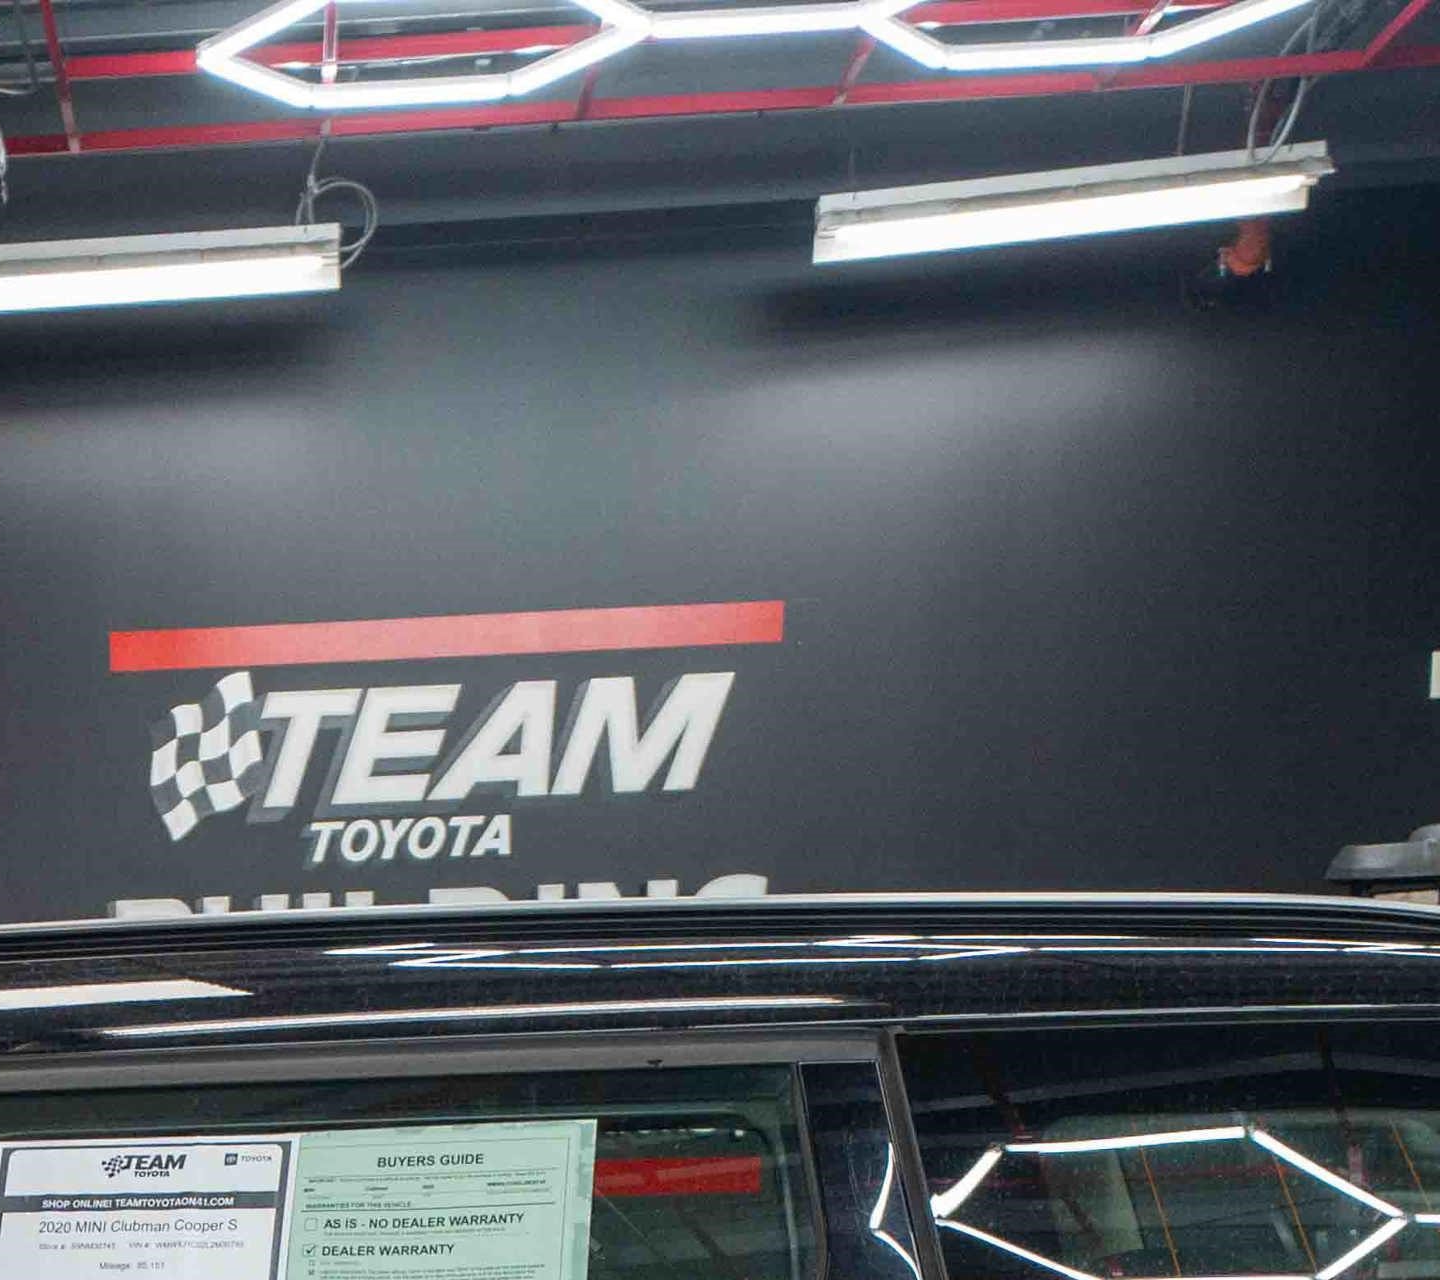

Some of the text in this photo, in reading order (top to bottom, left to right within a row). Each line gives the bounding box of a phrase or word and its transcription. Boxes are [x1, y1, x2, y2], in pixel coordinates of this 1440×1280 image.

[258, 671, 736, 809] TEAM
[309, 813, 512, 863] TOYOTA
[123, 1153, 187, 1170] TEAM
[377, 1152, 485, 1169] BUYERS GUIDE
[134, 1170, 170, 1178] TOYOTA
[41, 1196, 235, 1209] SHOP ONLINE! TEAMTOYOTAON41.COM
[38, 1218, 239, 1234] 2020 MINI Clubman Cooper S
[323, 1217, 342, 1230] AS
[345, 1217, 358, 1230] IS
[368, 1217, 389, 1230] NO
[391, 1215, 446, 1229] DEALER
[448, 1212, 525, 1227] WARRANTY
[321, 1242, 455, 1257] DEALER WARRANTY
